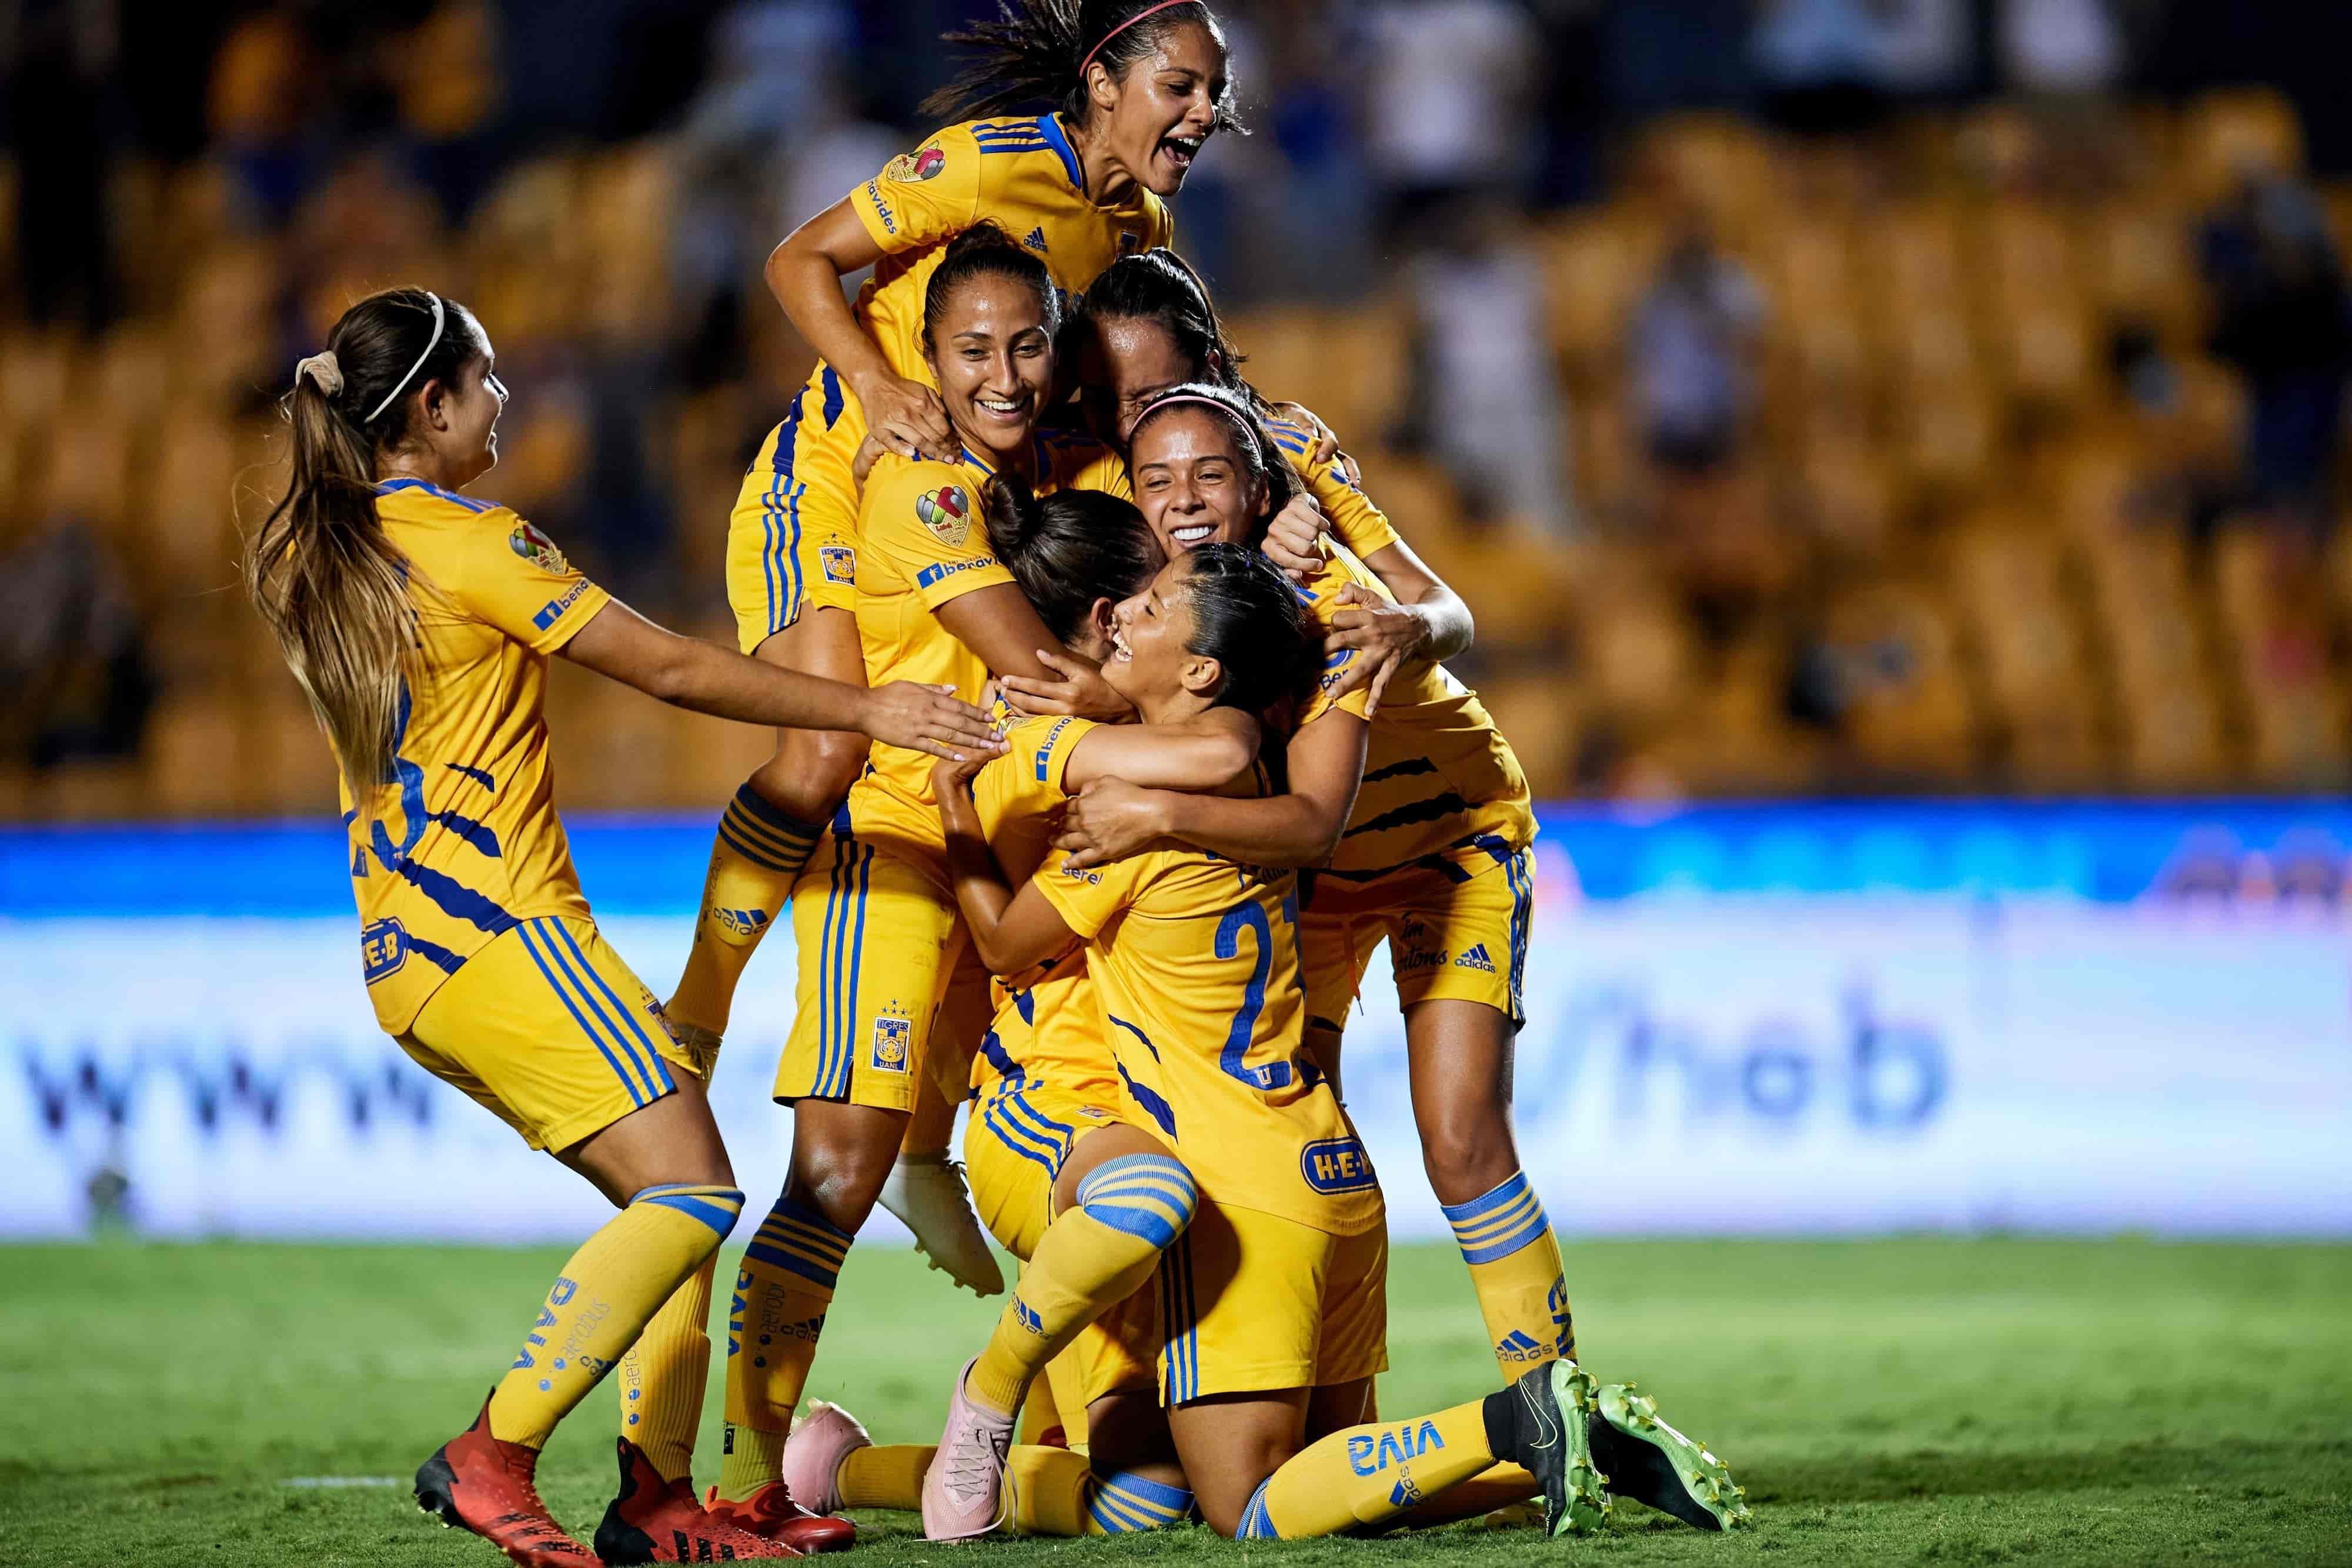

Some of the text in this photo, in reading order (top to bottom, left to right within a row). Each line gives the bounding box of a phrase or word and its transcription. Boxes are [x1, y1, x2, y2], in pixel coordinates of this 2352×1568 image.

[1041, 716, 1078, 750] bena
[1455, 957, 1496, 974] adidas
[877, 1019, 908, 1032] TIGRES
[879, 1060, 898, 1070] UANL
